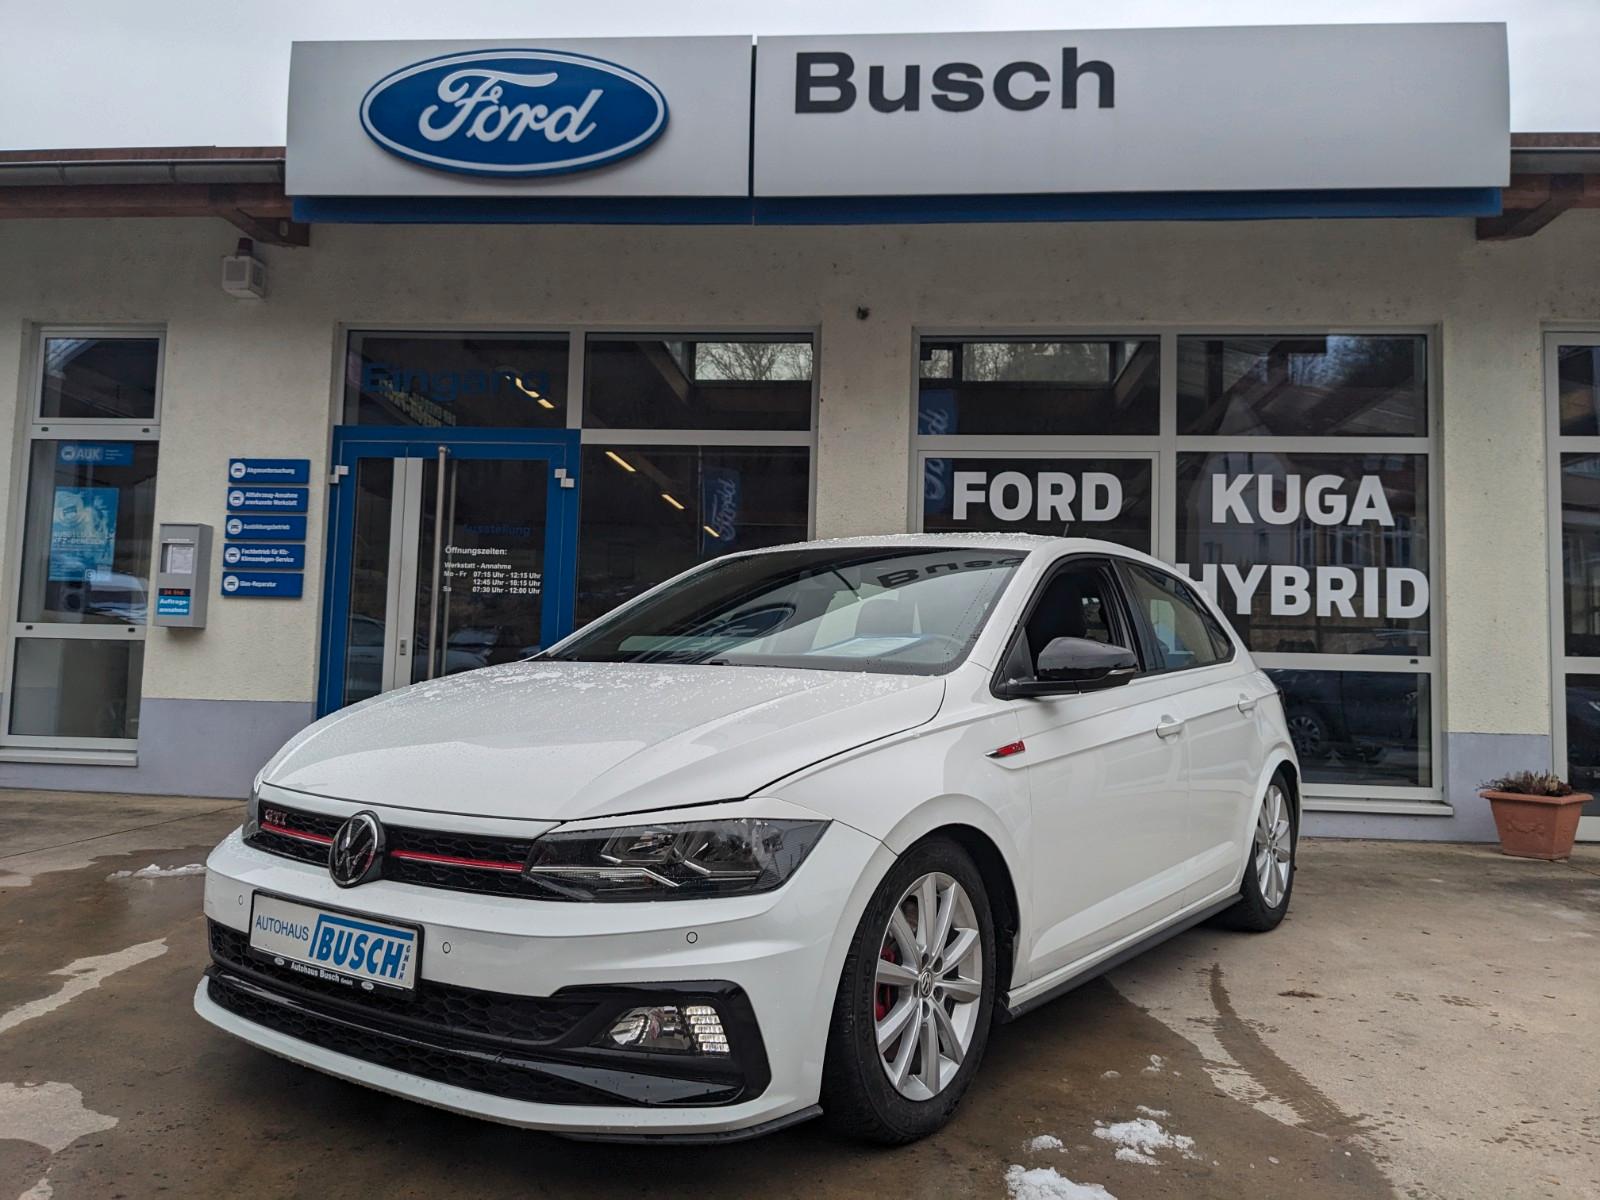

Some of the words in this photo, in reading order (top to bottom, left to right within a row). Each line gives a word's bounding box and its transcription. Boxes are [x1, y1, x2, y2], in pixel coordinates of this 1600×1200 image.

[795, 46, 1115, 114] Busch
[418, 68, 605, 143] Ford
[363, 364, 549, 402] Eingang
[953, 471, 1123, 522] FORD
[1212, 473, 1395, 526] KUGA
[445, 545, 508, 556] Öffnungszeiten:
[480, 562, 512, 570] Annahme
[1176, 563, 1430, 619] HYBRID
[265, 808, 287, 826] GTI
[255, 914, 309, 941] AUTOHAUS
[316, 926, 405, 979] BUSCH
[290, 962, 319, 977] Autohaus
[319, 969, 340, 983] Busch
